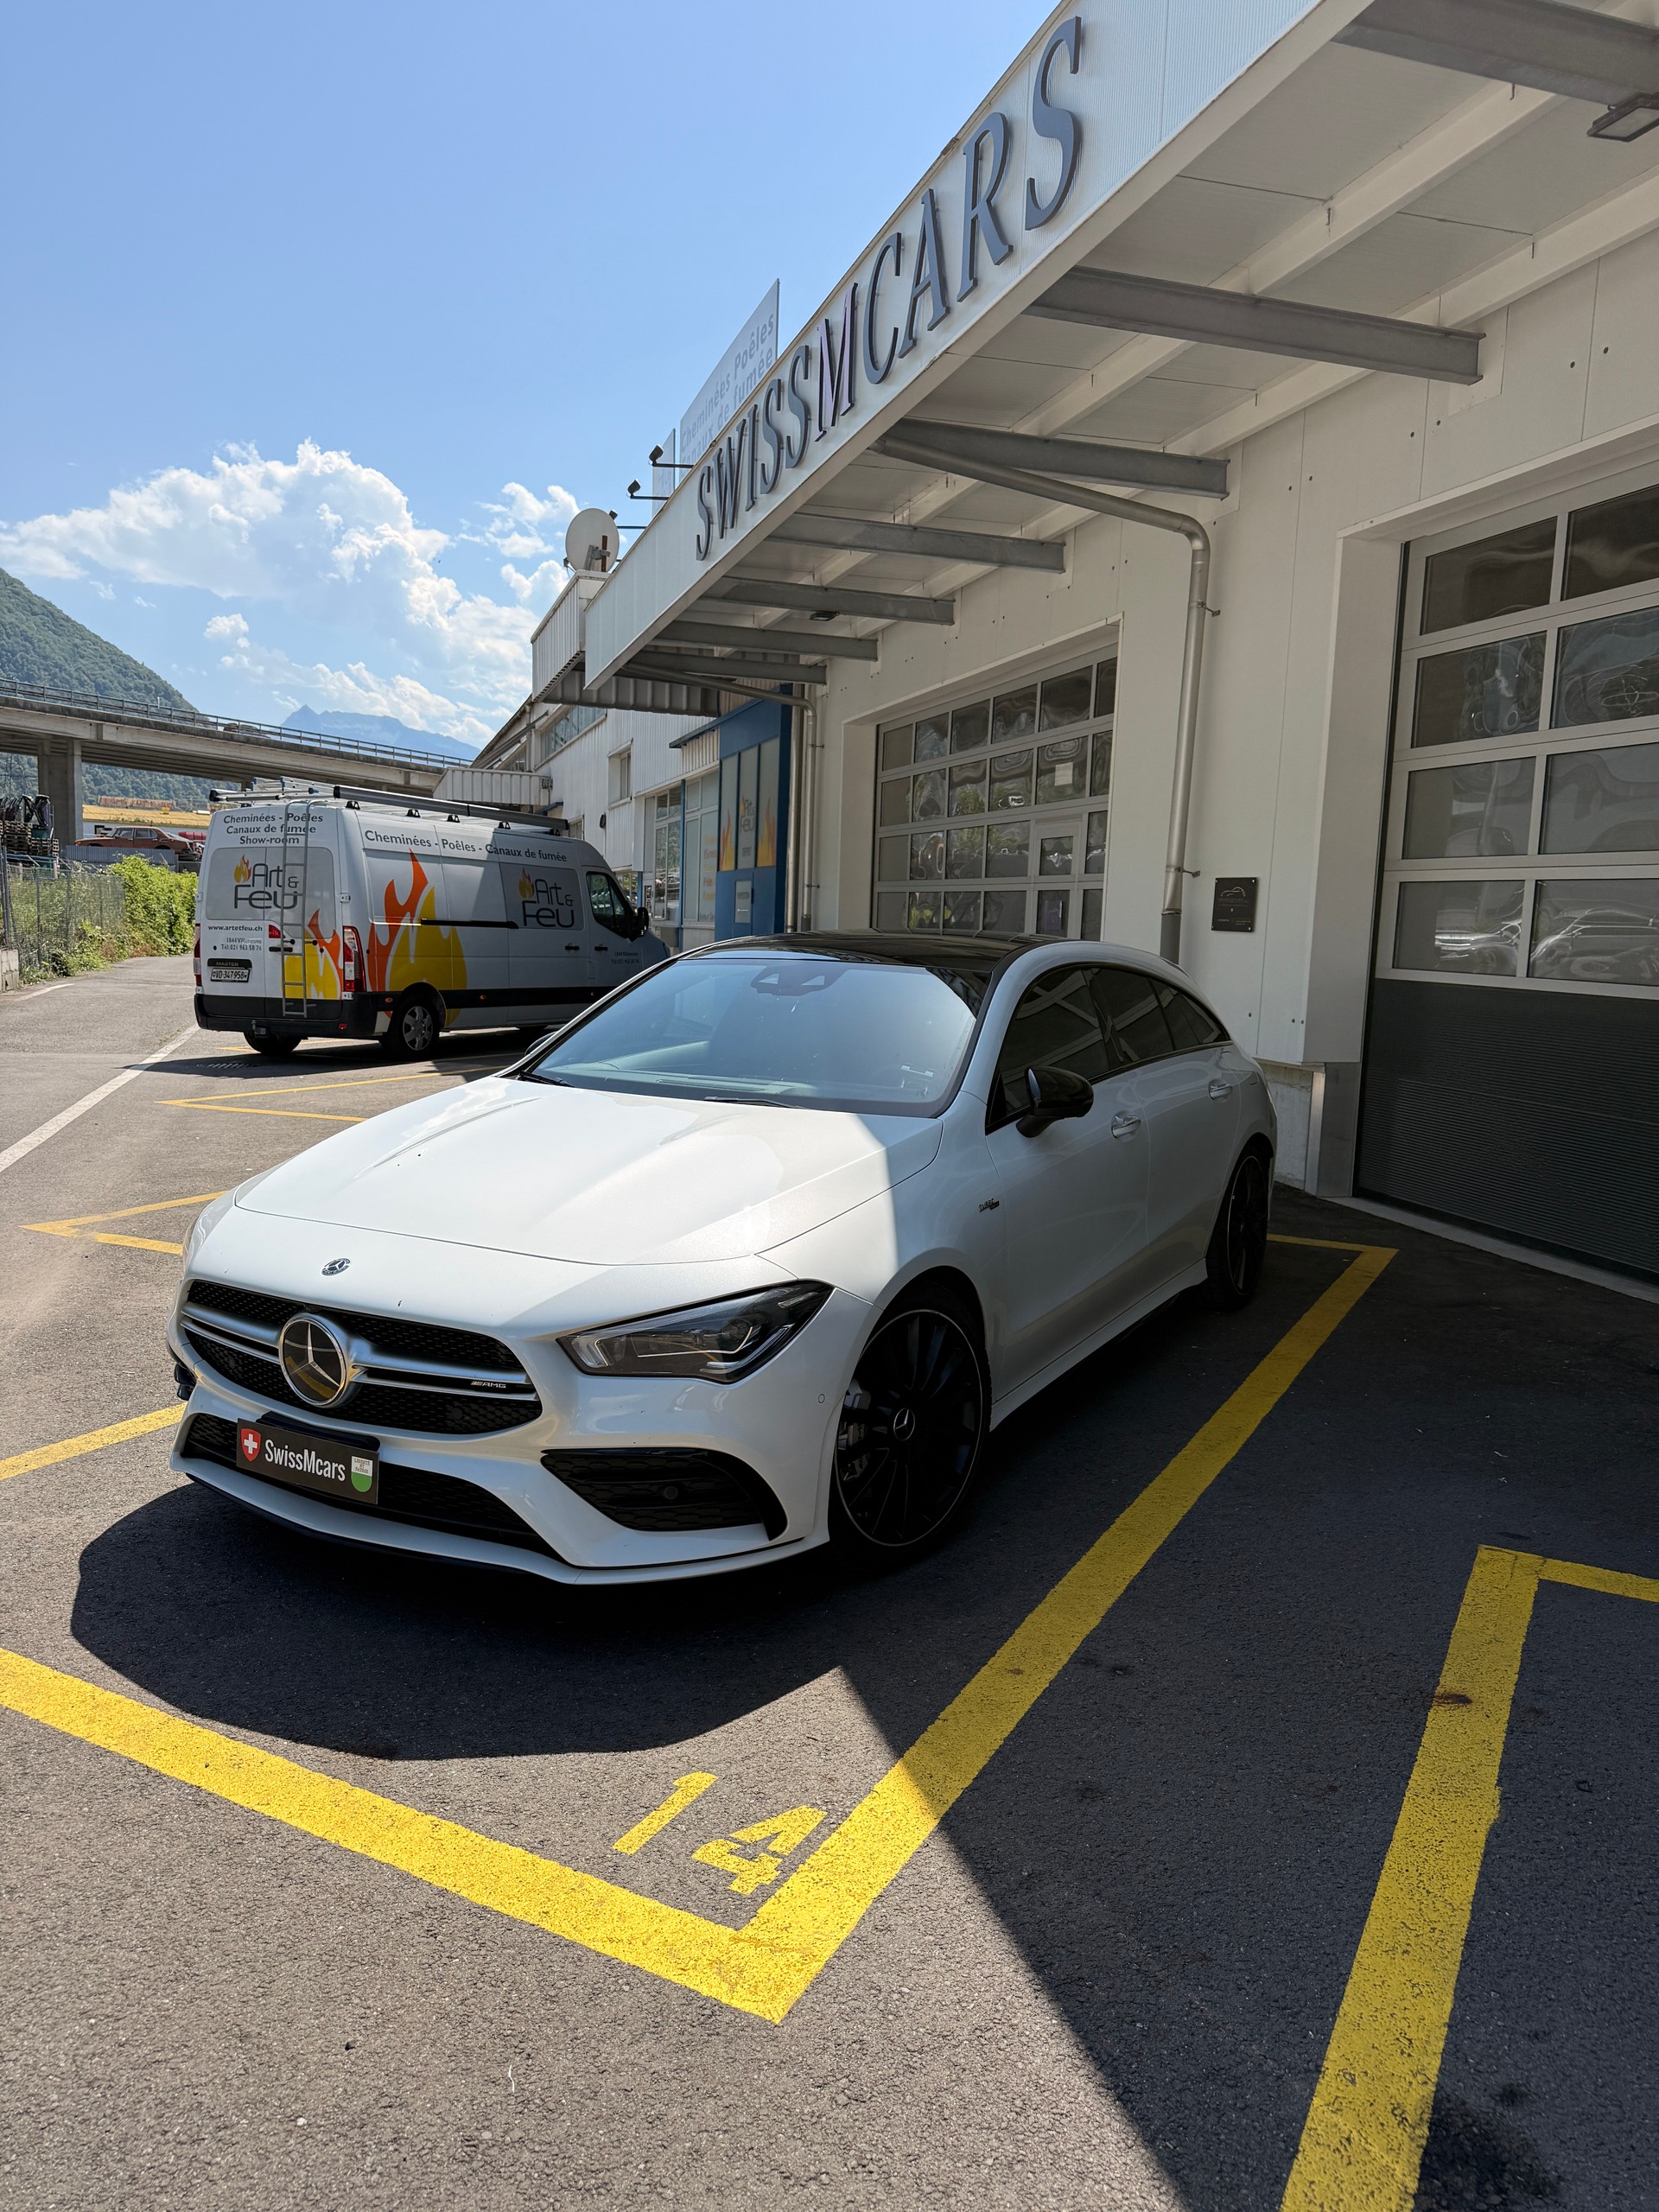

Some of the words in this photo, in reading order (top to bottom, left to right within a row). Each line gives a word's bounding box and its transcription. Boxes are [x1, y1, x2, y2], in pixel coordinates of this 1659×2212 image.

[696, 16, 1083, 561] SWISSMCARS
[734, 314, 774, 378] Poêles
[717, 404, 731, 428] de
[734, 346, 774, 411] fumée
[223, 813, 276, 823] Cheminées
[287, 812, 324, 823] Poêles
[226, 825, 262, 835] Canaux
[264, 823, 277, 834] de
[239, 836, 301, 845] Show-room
[365, 830, 433, 848] Cheminées
[442, 838, 476, 852] Poêles
[485, 843, 522, 858] Canaux
[524, 848, 537, 859] de
[538, 849, 568, 862] fumée
[251, 863, 283, 888] Art
[287, 875, 300, 888] &
[535, 878, 563, 906] Art
[264, 1439, 346, 1482] SwissMcars
[611, 1771, 828, 1896] 14
